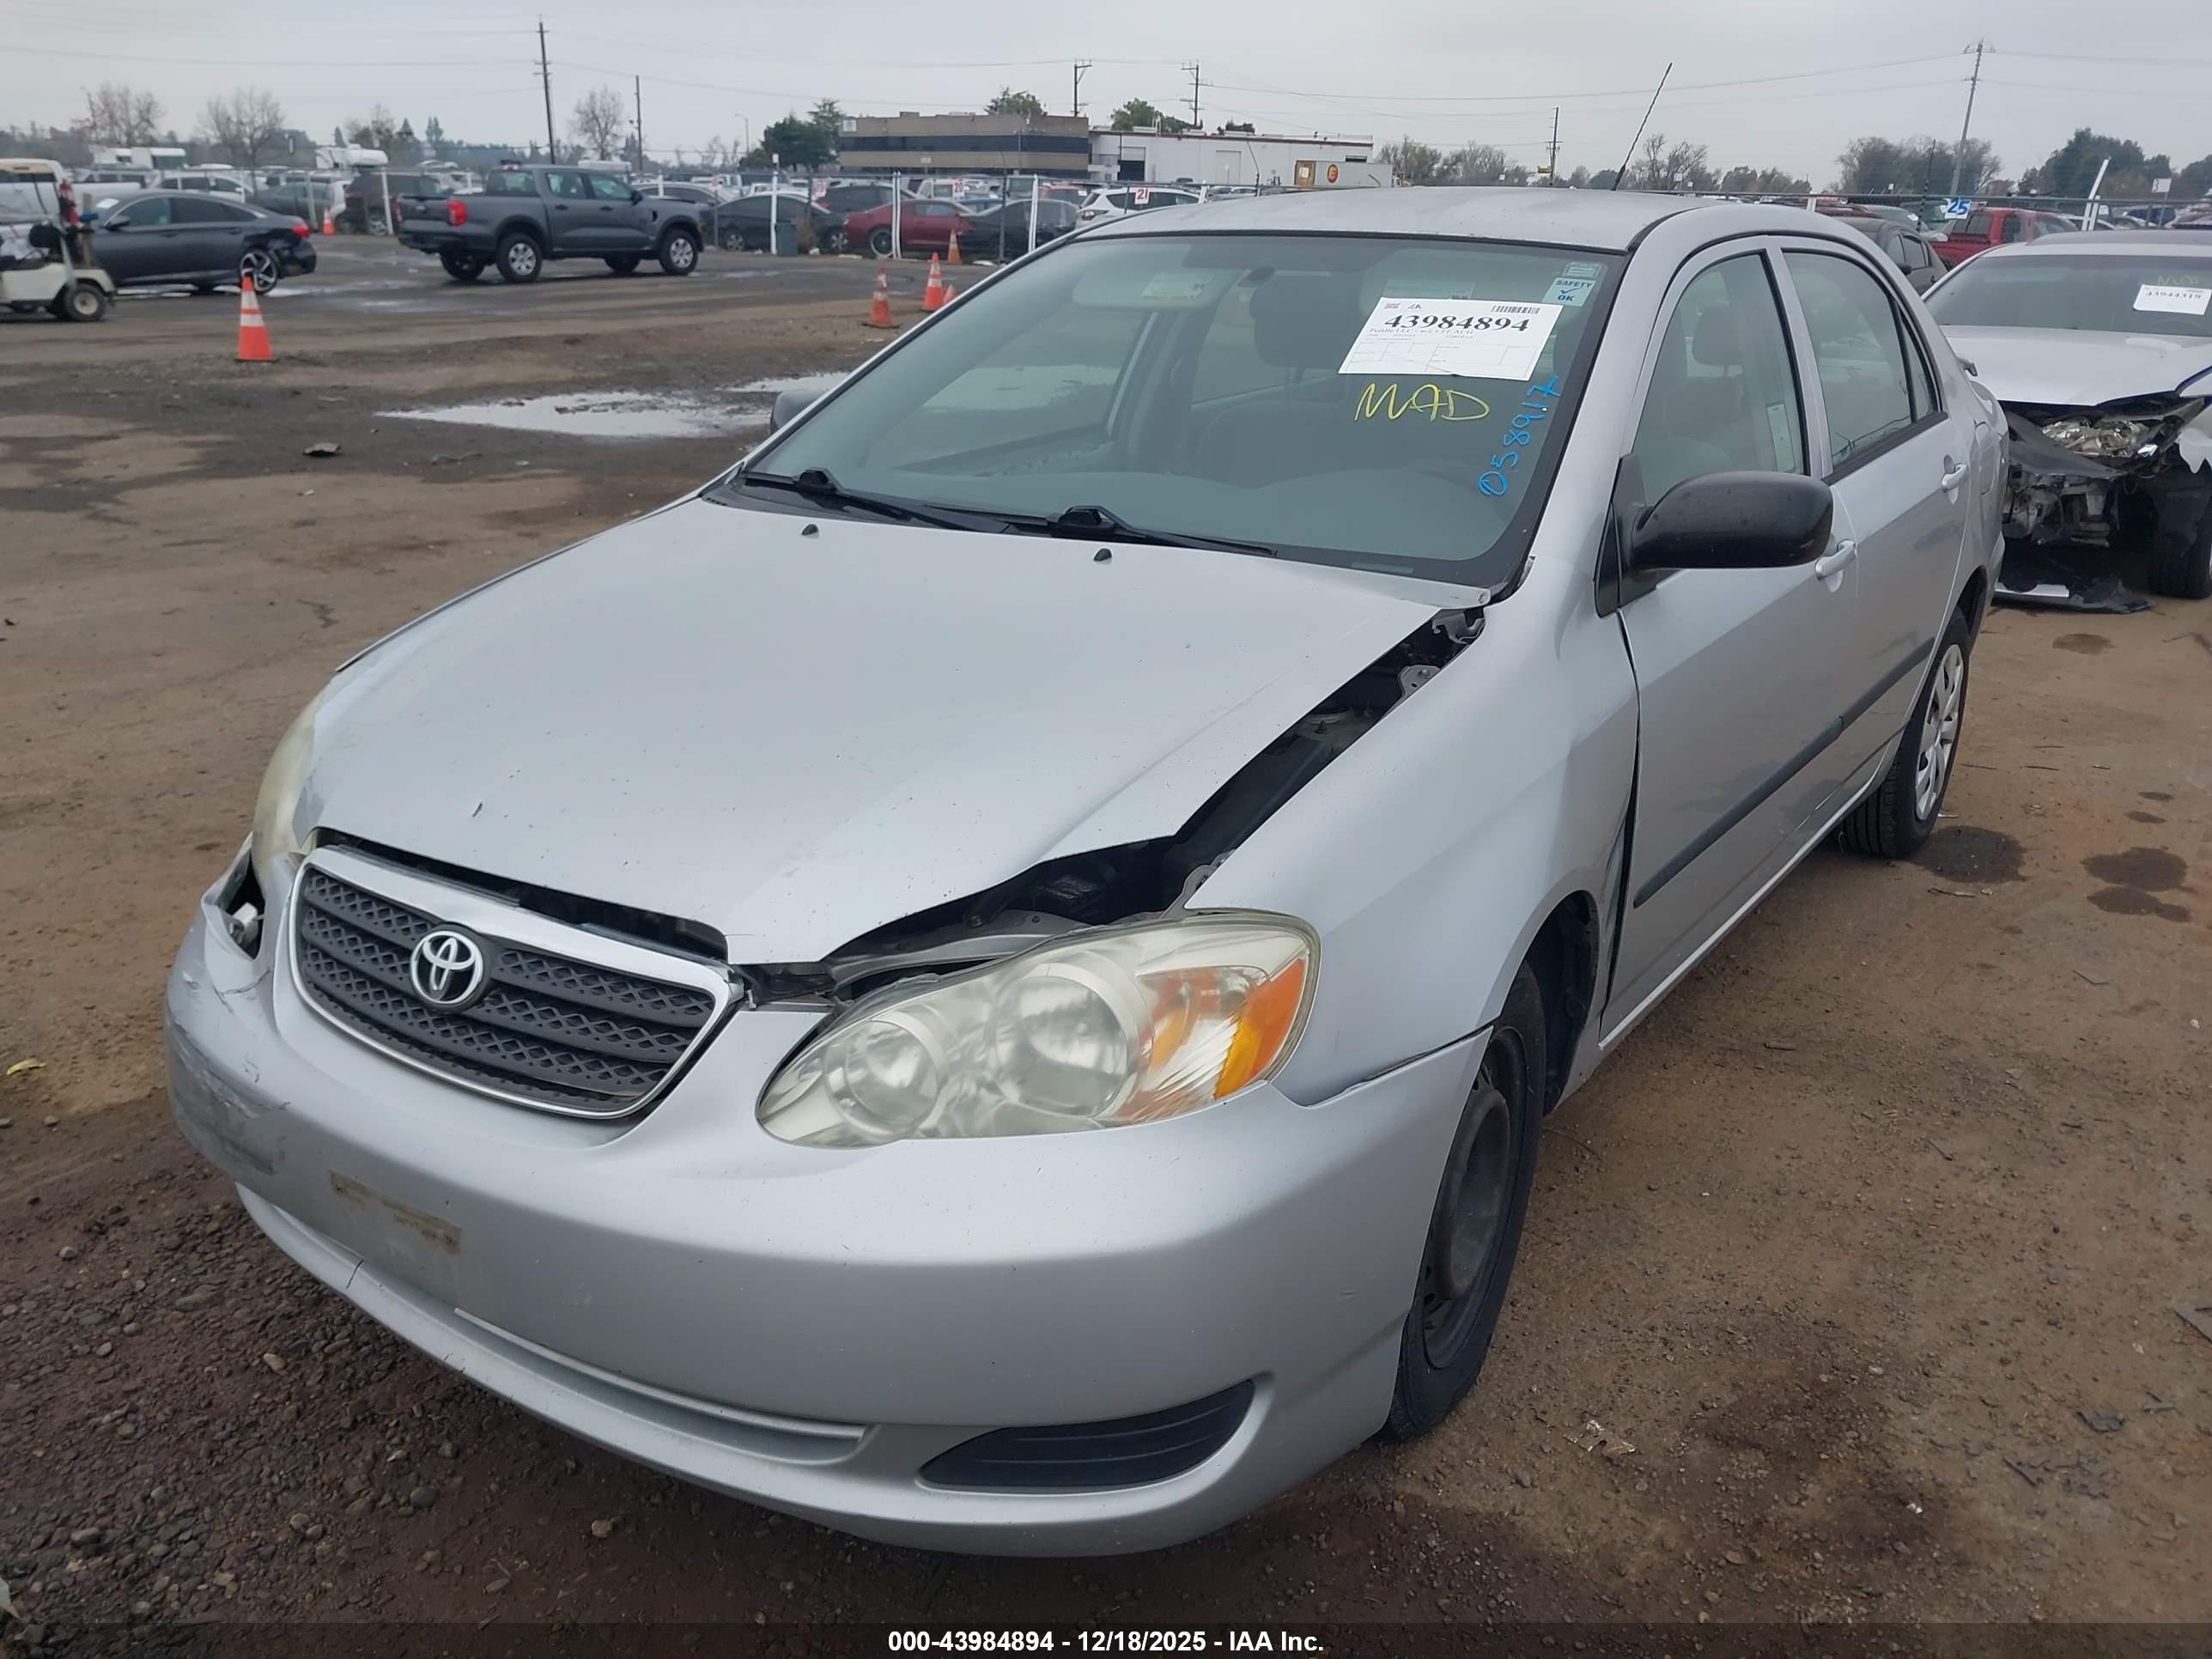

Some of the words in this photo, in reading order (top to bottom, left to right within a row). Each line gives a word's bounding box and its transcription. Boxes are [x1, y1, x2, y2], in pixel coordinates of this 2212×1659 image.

[1137, 188, 1148, 199] 21
[1948, 198, 1971, 215] 25
[1384, 314, 1530, 331] 43984894
[1354, 383, 1490, 422] MAD
